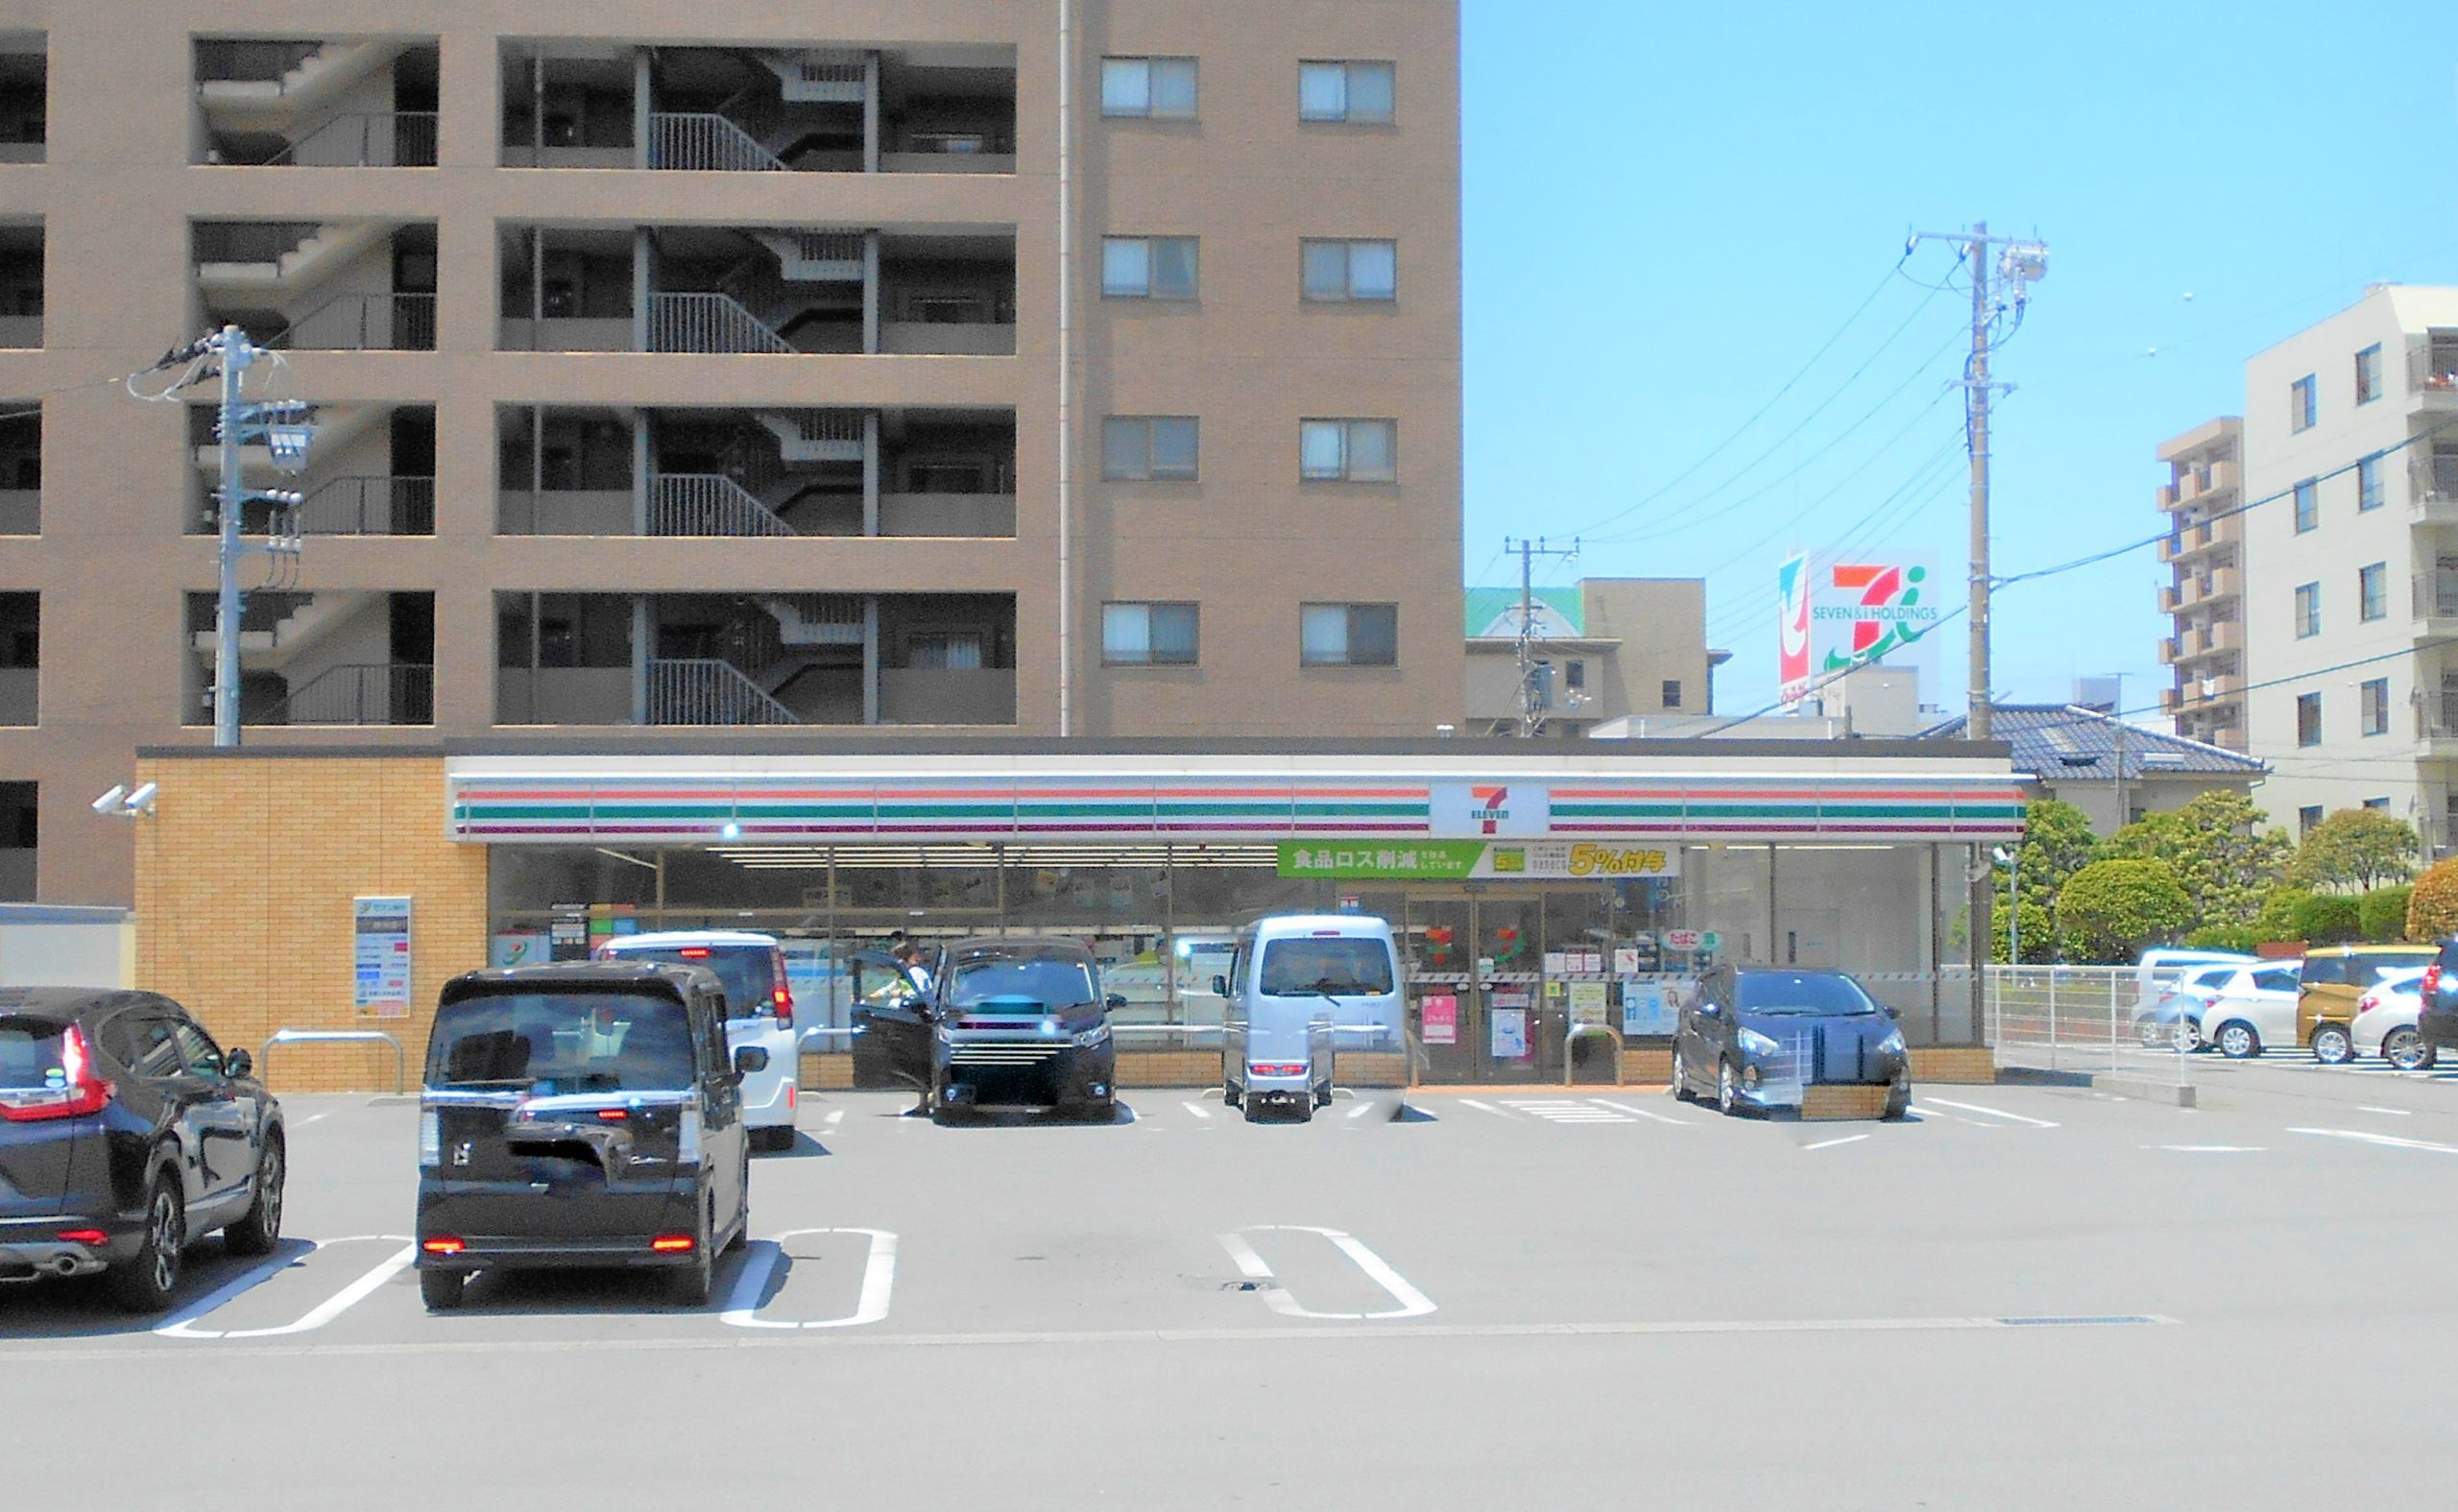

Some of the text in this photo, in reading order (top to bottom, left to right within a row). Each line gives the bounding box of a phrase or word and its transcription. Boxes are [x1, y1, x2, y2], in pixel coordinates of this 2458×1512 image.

[1871, 607, 1938, 620] HOLDINGS
[1471, 786, 1507, 834] 7
[1292, 849, 1417, 869] 食品ロス削減
[1568, 843, 1667, 876] 5%付与
